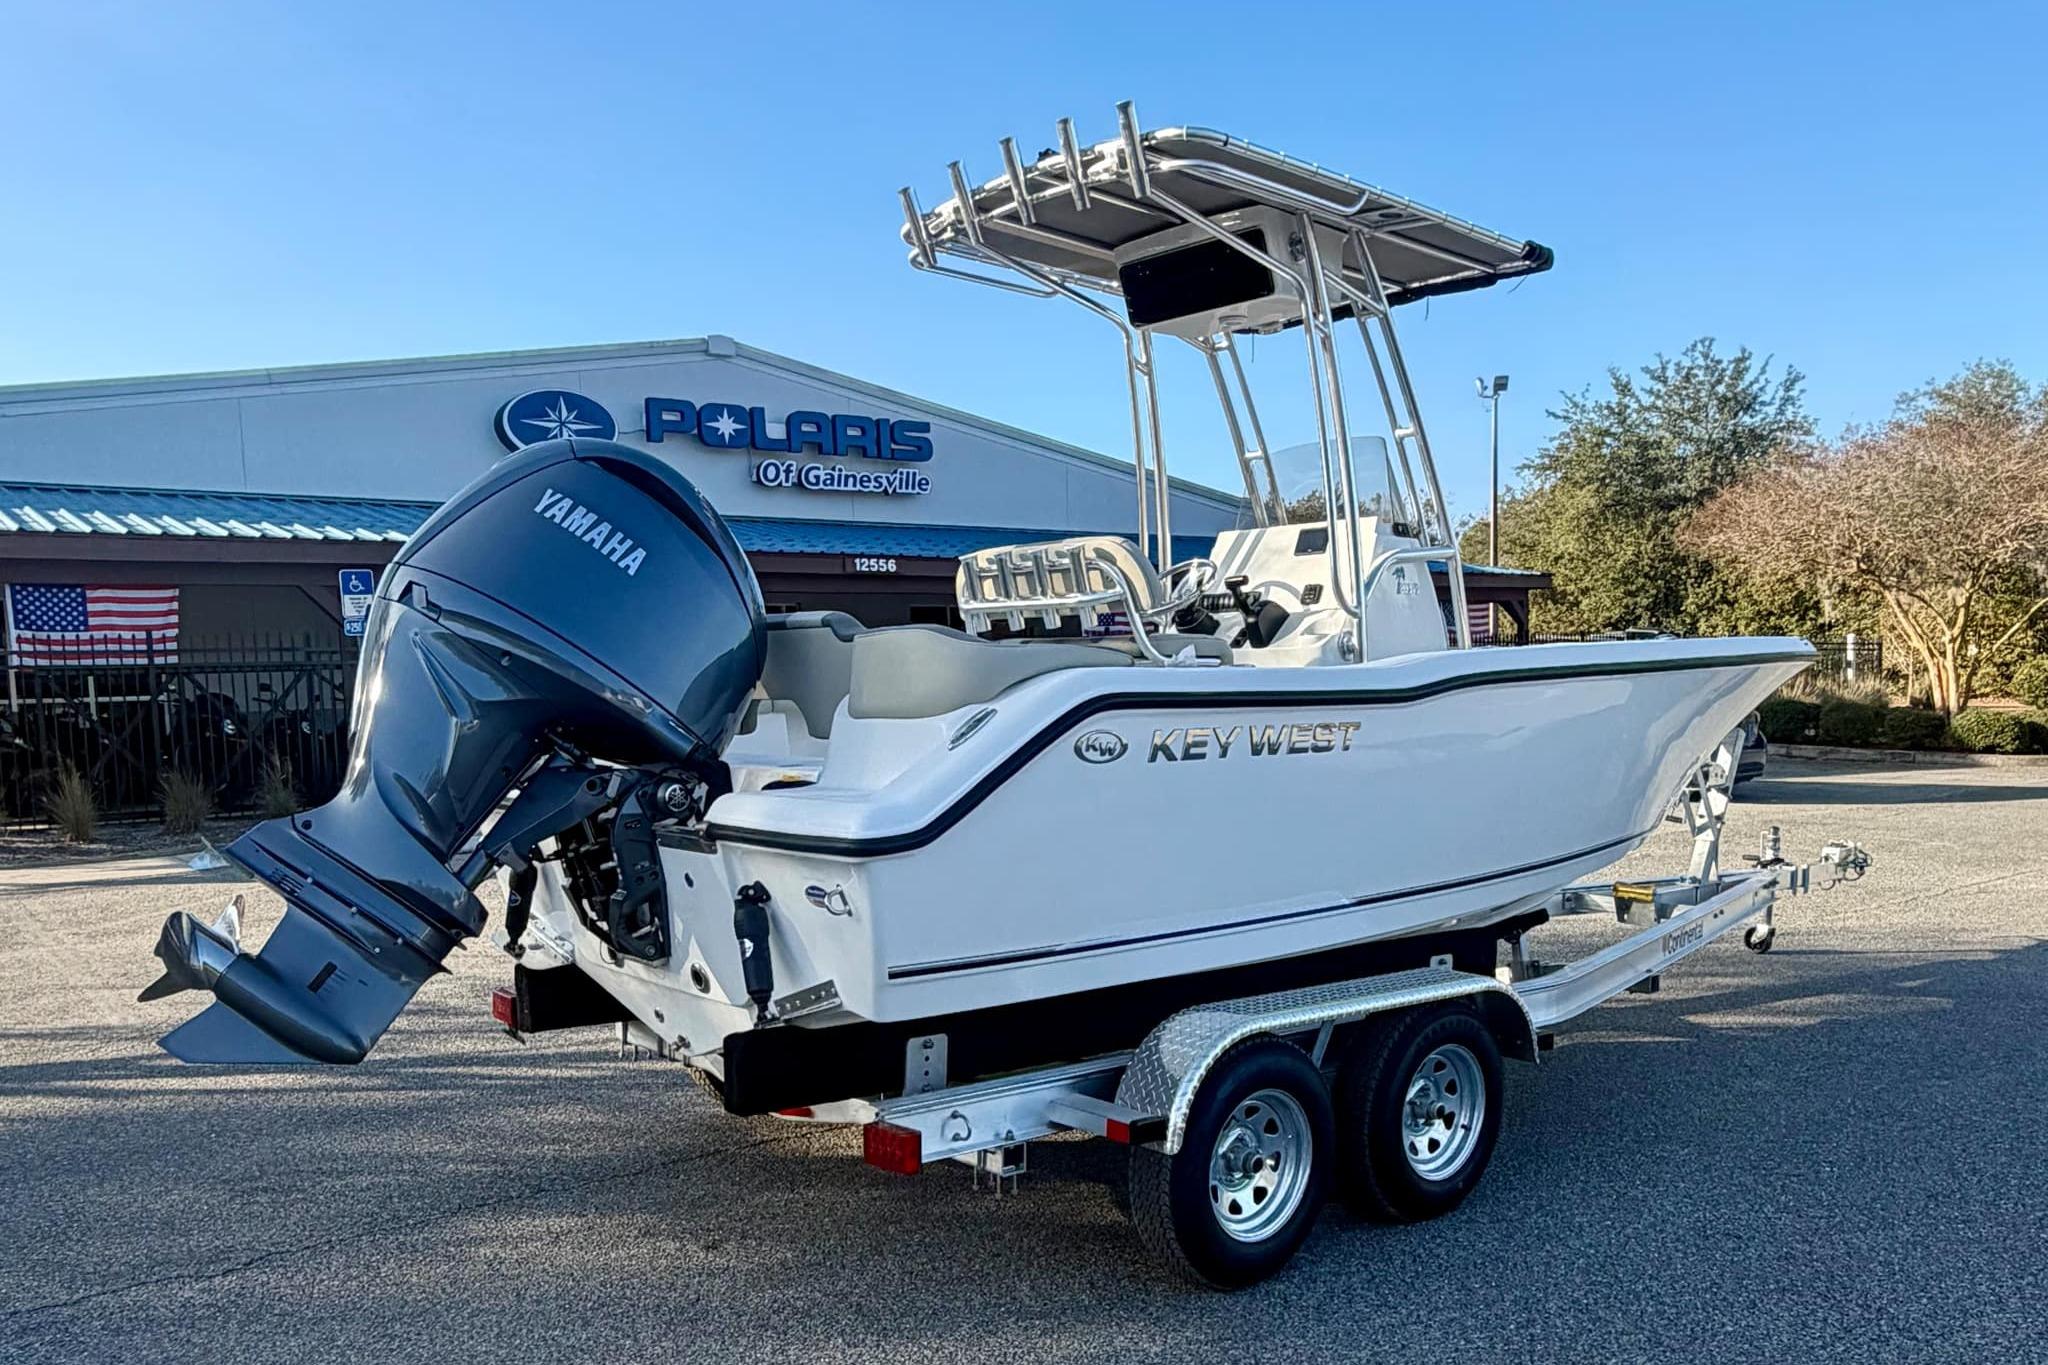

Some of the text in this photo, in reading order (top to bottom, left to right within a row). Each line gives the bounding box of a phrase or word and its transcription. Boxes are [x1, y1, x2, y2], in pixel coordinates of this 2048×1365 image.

[645, 397, 934, 462] POLARIS
[758, 459, 931, 495] Of Gainesville
[534, 488, 647, 577] YAMAHA
[854, 557, 897, 572] 12556
[1147, 721, 1362, 763] KEY WEST
